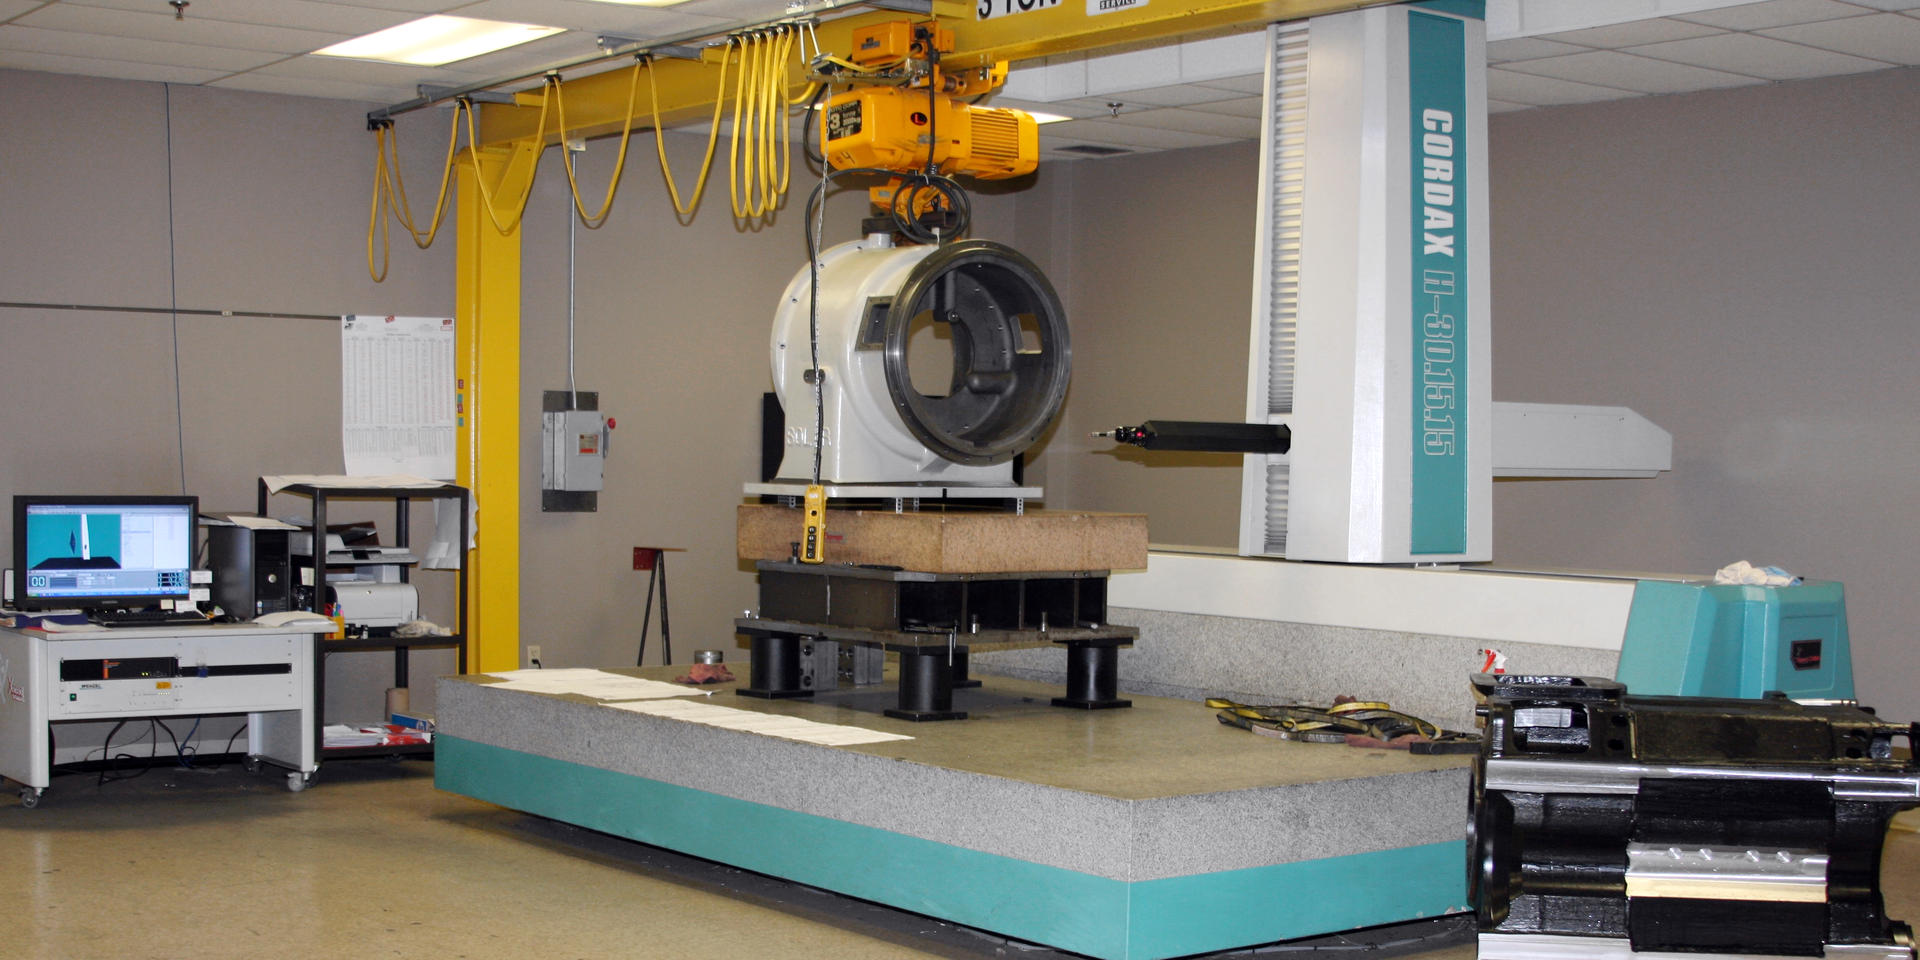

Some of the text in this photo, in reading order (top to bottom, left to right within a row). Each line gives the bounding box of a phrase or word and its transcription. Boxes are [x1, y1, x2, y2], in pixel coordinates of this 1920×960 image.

[829, 113, 841, 130] 3
[1423, 108, 1455, 456] CORDAX H-30.15.15
[787, 426, 832, 447] SOLR
